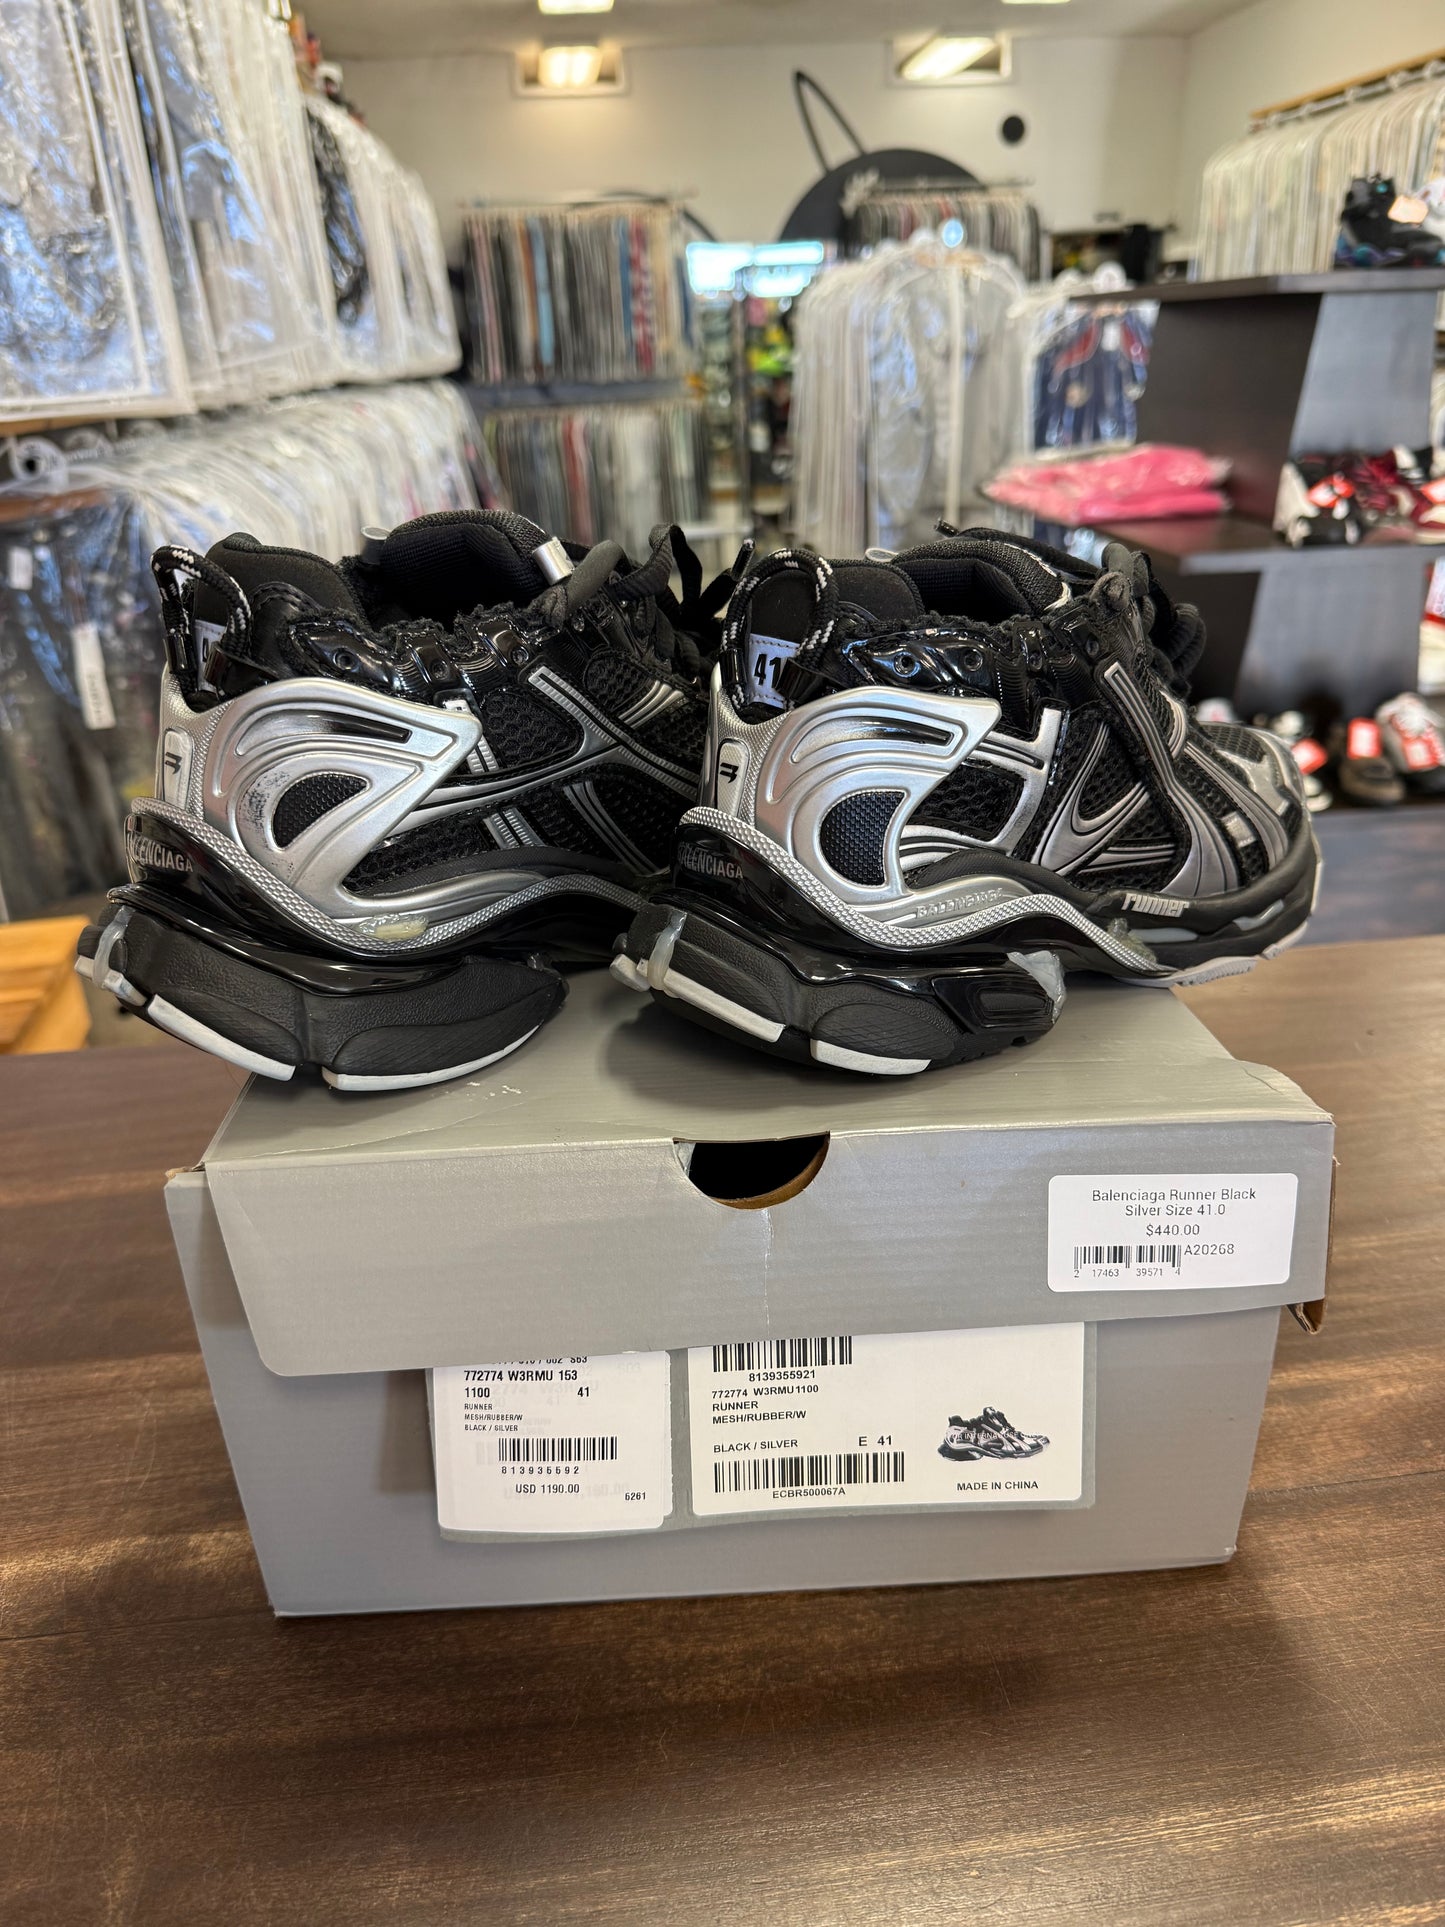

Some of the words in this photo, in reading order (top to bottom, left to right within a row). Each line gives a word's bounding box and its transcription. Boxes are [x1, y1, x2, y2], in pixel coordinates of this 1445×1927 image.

[753, 653, 783, 689] 41
[1121, 892, 1190, 918] runner
[1092, 1189, 1166, 1204] Balenciaga
[1169, 1189, 1216, 1201] Runner
[1220, 1188, 1257, 1201] Black
[1124, 1202, 1162, 1217] Silver
[1165, 1204, 1193, 1216] Size
[1196, 1204, 1226, 1216] 41.0
[1145, 1224, 1200, 1238] $440.00
[1183, 1244, 1235, 1256] A20268
[1073, 1270, 1080, 1279] 2
[1092, 1269, 1120, 1278] 17463
[1135, 1268, 1163, 1277] 39571
[1173, 1266, 1182, 1276] 4
[463, 1370, 504, 1382] 772774
[507, 1370, 554, 1382] W3RMU
[558, 1370, 578, 1382] 153
[748, 1369, 817, 1382] 8139355921
[464, 1387, 491, 1399] 1100
[577, 1387, 590, 1398] 41
[711, 1389, 748, 1400] 772774
[753, 1385, 819, 1397] W3RMU1100
[463, 1403, 493, 1411] RUNNER
[712, 1401, 759, 1413] RUNNER
[464, 1414, 524, 1422] MESH/RUBBER/W
[712, 1410, 807, 1425] MESH/RUBBER/W
[464, 1424, 487, 1432] BLACK
[713, 1442, 752, 1454] BLACK
[753, 1442, 758, 1451] /
[760, 1439, 799, 1450] SILVER
[858, 1436, 868, 1447] E
[876, 1435, 892, 1446] 41
[515, 1484, 537, 1494] USD
[540, 1484, 580, 1495] 1190.00
[771, 1485, 846, 1499] ECBR500067A
[956, 1482, 988, 1491] MADE
[991, 1482, 1002, 1490] IN
[1004, 1481, 1039, 1490] CHINA
